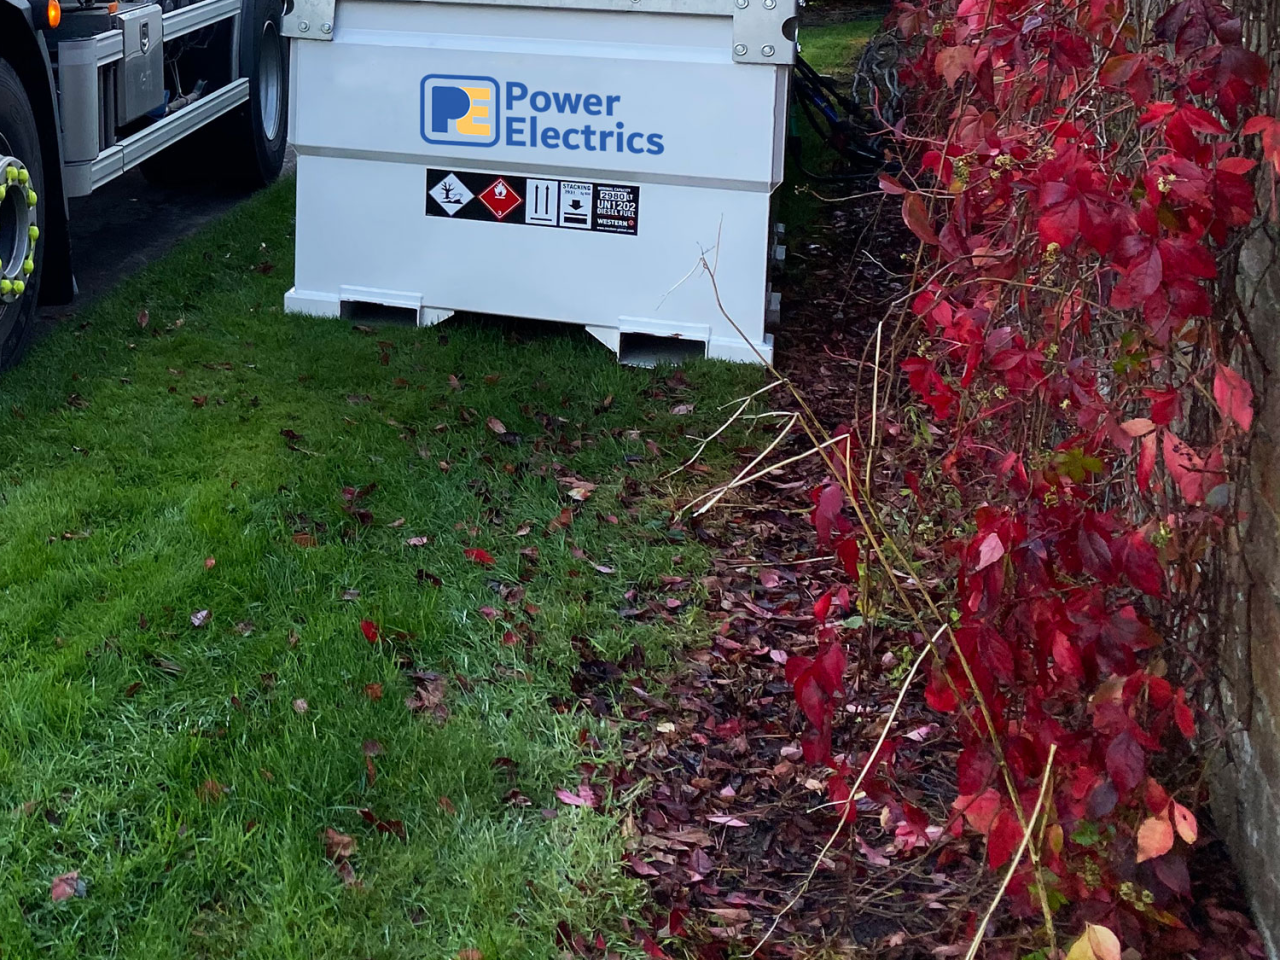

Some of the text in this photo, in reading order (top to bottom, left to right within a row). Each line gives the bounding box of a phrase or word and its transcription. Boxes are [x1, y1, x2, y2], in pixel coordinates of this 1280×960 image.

[505, 81, 621, 116] Power
[505, 116, 665, 156] Electrics
[563, 183, 591, 191] STACKING
[601, 191, 625, 200] 2980
[597, 200, 636, 211] UN1202
[597, 208, 619, 216] DIESEL
[597, 218, 628, 226] WESTERN
